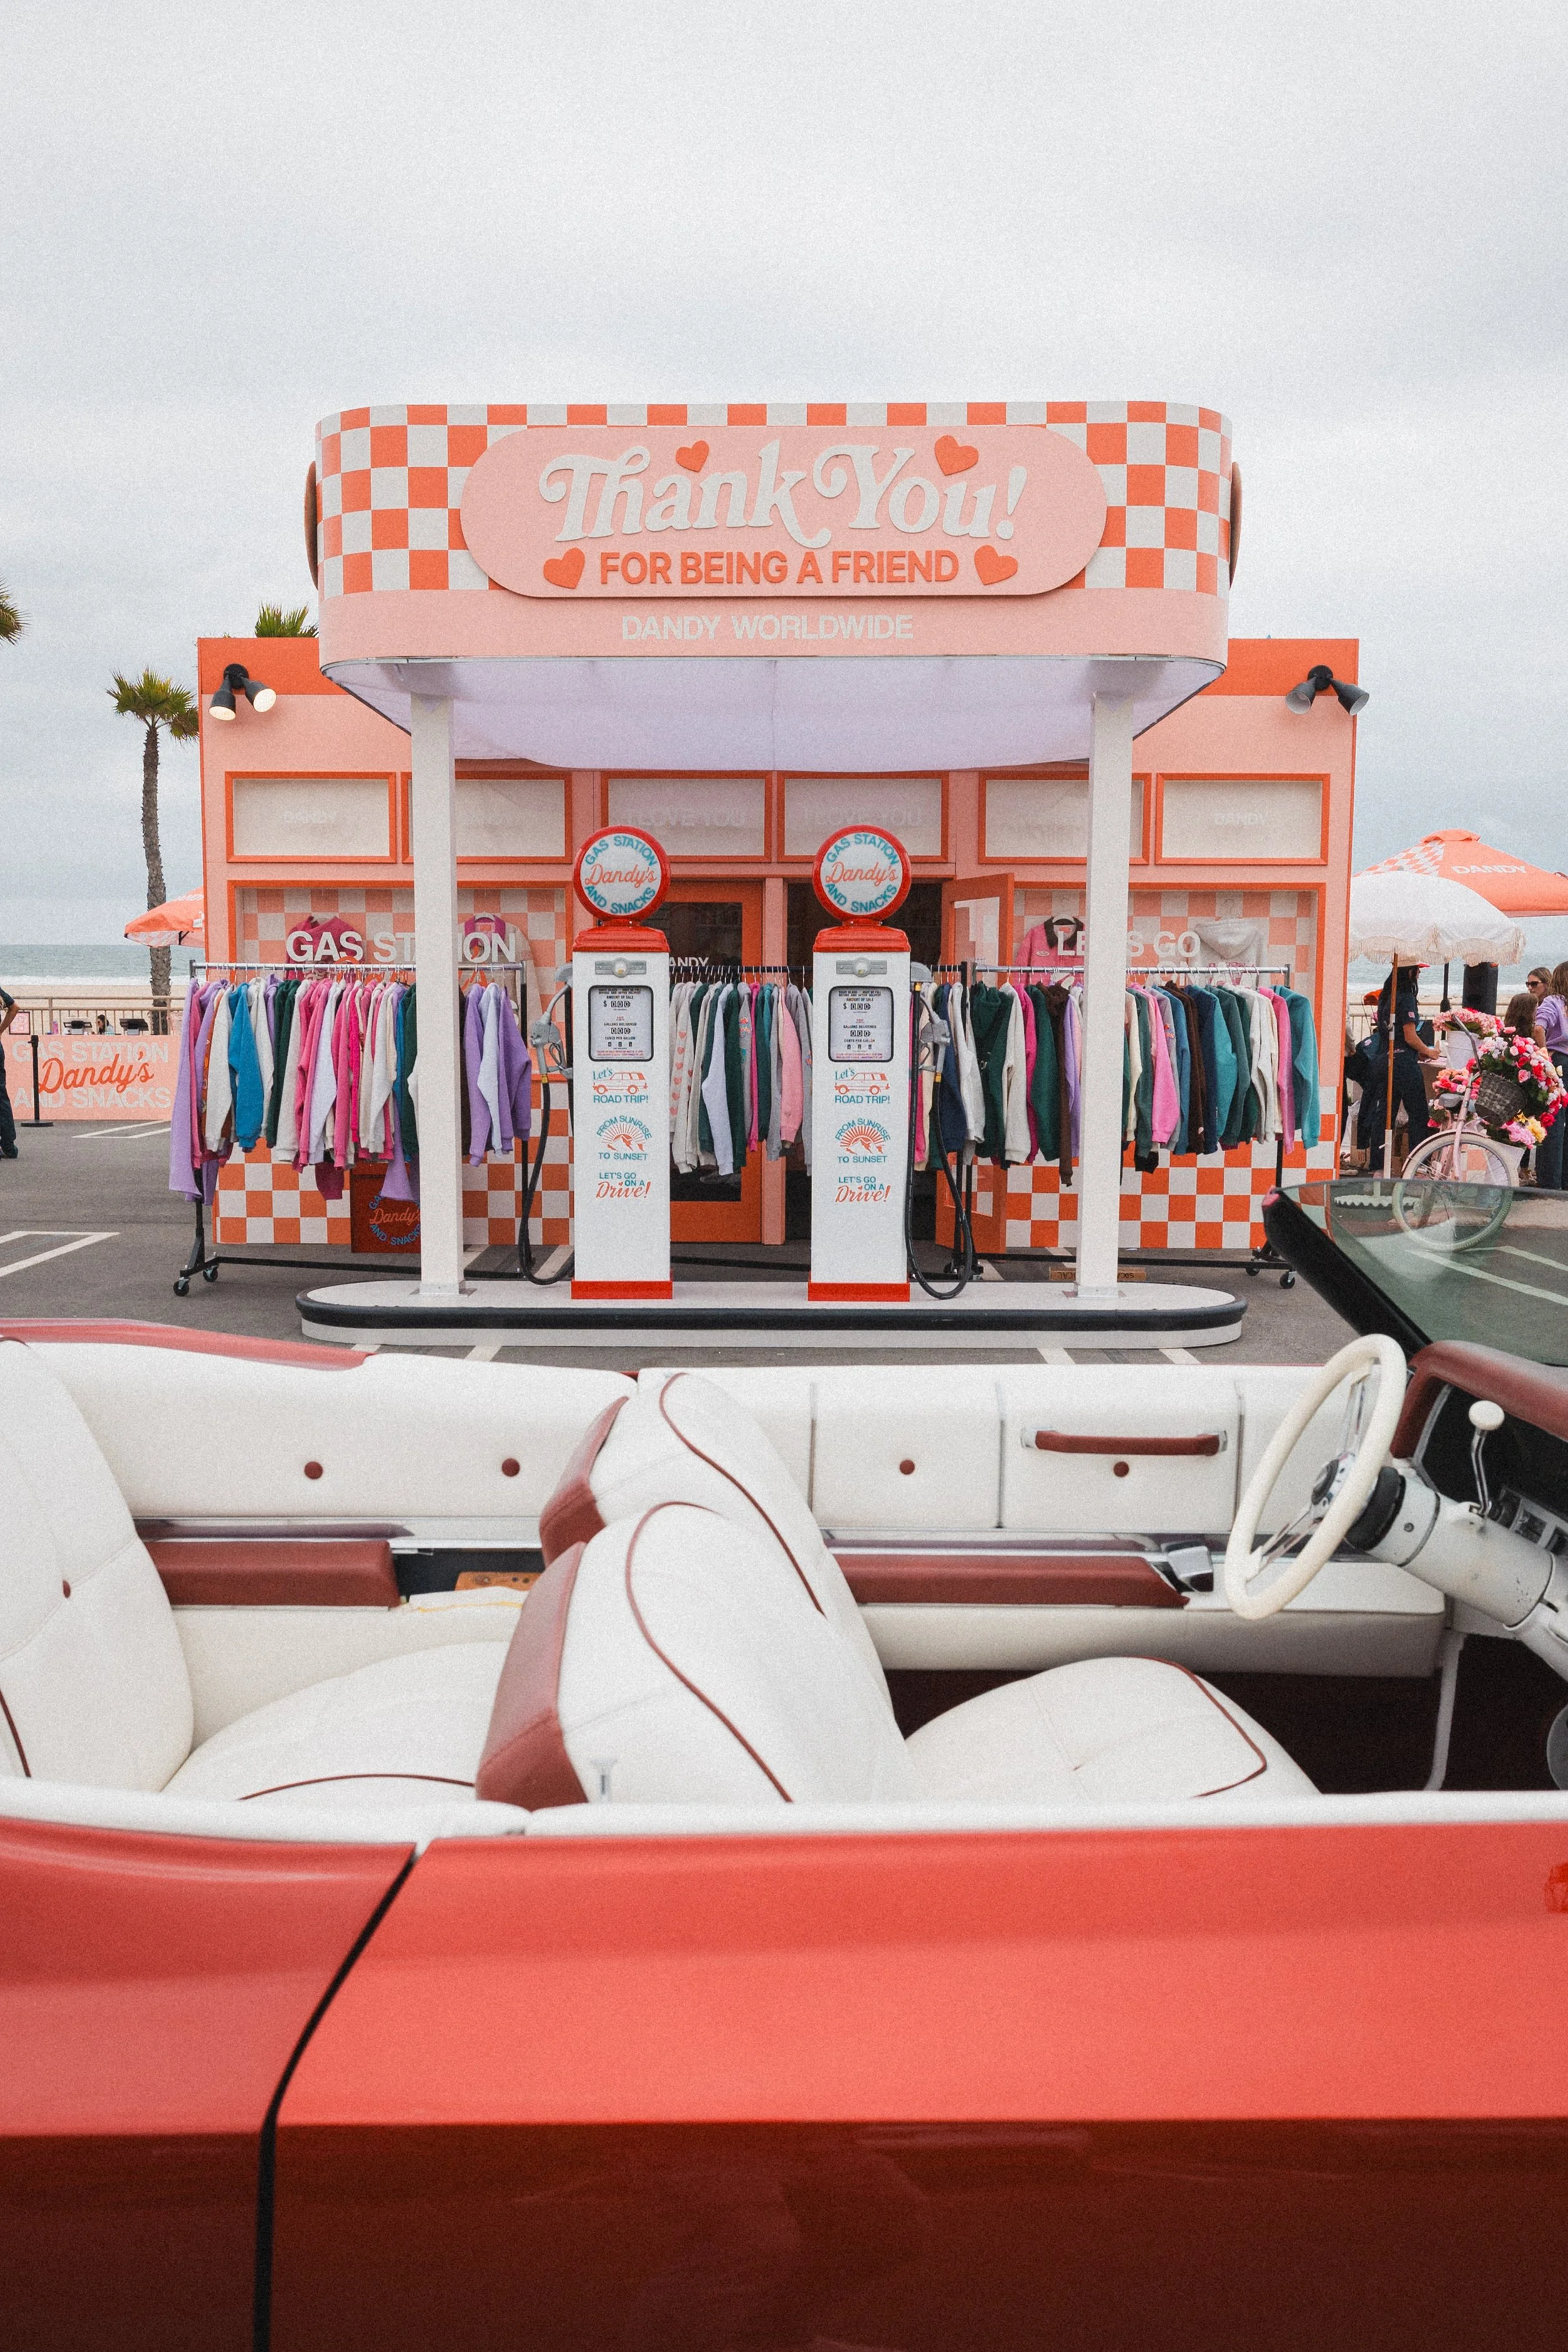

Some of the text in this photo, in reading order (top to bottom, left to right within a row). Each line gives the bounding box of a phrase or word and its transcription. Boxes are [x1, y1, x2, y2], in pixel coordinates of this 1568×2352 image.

[539, 439, 1027, 548] Thank You!
[600, 550, 960, 584] FOR BEING A FRIEND
[622, 615, 914, 640] DANDY WORLDWIDE
[585, 835, 657, 867] GAS STATION
[826, 833, 900, 866] GAS STATION
[584, 863, 657, 889] Dandy's
[825, 861, 899, 887] Dandy's
[1451, 865, 1527, 874] DANDY
[585, 885, 656, 914] AND SNACKS
[825, 883, 898, 913] AND SNACKS
[285, 931, 516, 963] GAS STION
[1153, 930, 1201, 958] GO
[669, 957, 709, 967] ANDY
[12, 1041, 169, 1063] GAS STATION
[38, 1051, 154, 1094] Dandy's
[593, 1067, 613, 1080] Let's
[834, 1067, 856, 1080] Let's
[14, 1087, 171, 1109] AND SNACKS
[593, 1094, 649, 1104] ROAD TRIP!
[835, 1095, 890, 1104] ROAD TRIP!
[596, 1115, 652, 1140] FROM SUNRISE
[835, 1118, 891, 1142] FROM SUNRISE
[369, 1191, 382, 1209] GA
[596, 1181, 651, 1198] Drive!
[835, 1185, 891, 1202] Drive!
[370, 1224, 387, 1241] AND
